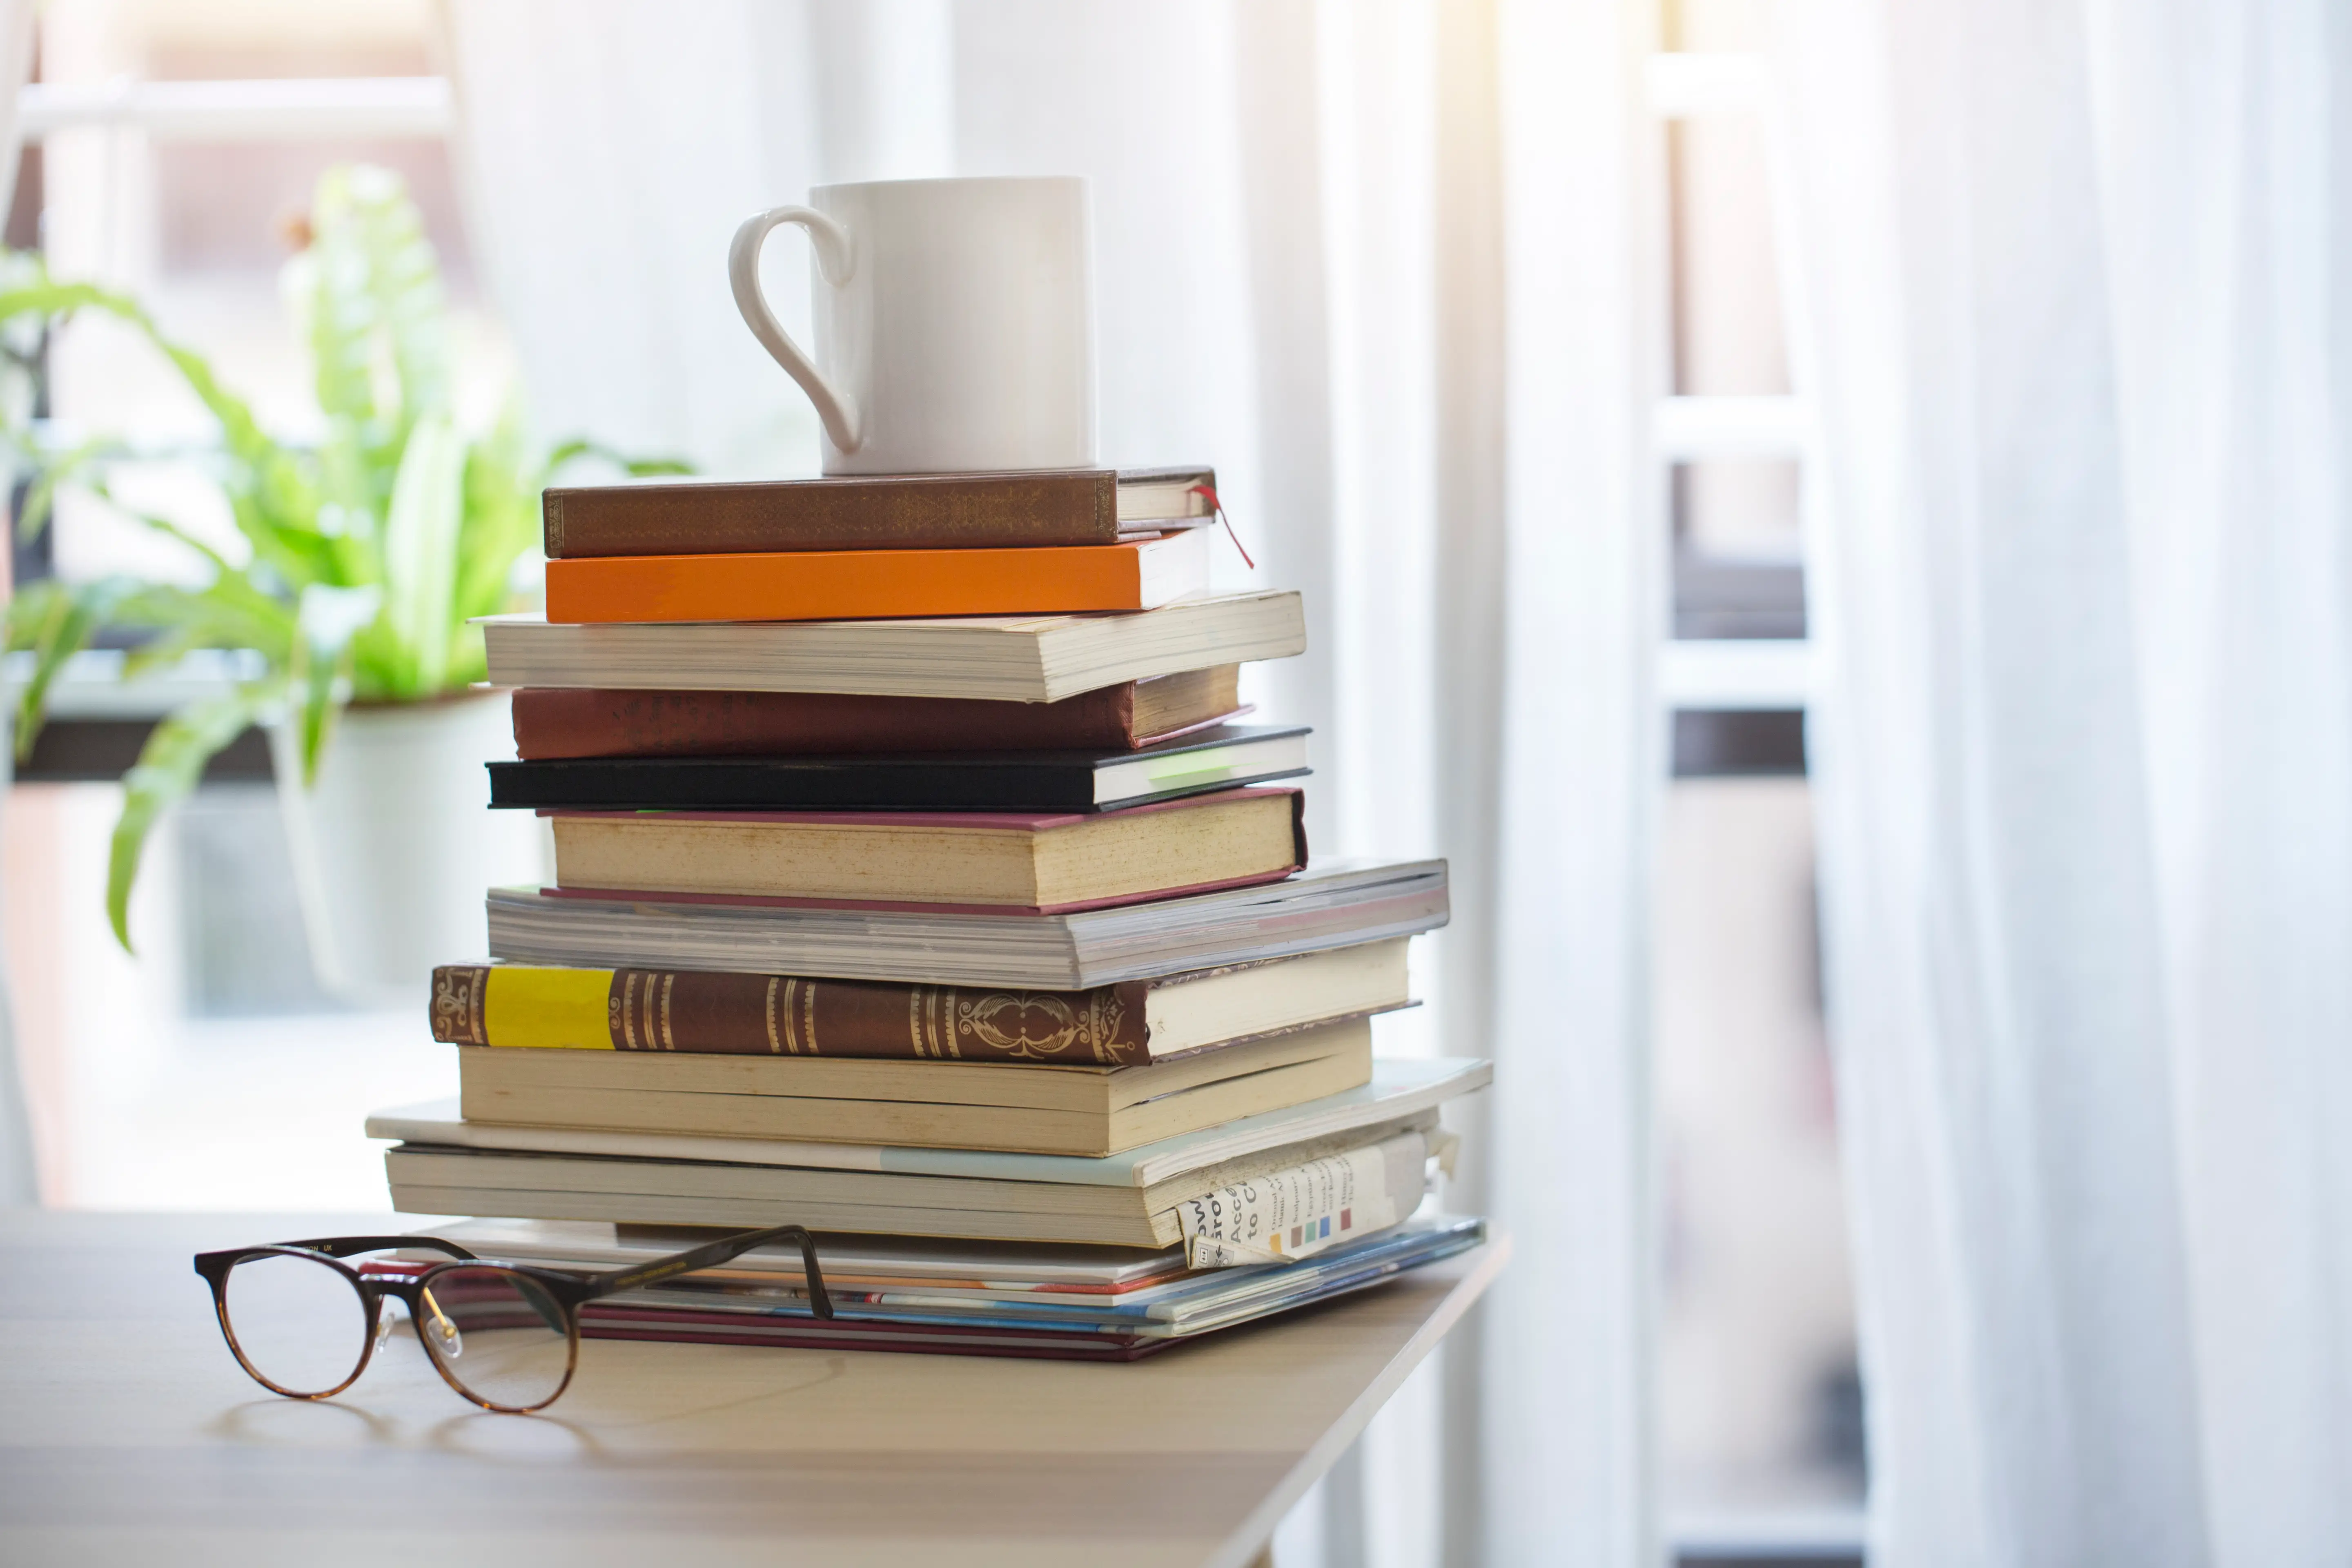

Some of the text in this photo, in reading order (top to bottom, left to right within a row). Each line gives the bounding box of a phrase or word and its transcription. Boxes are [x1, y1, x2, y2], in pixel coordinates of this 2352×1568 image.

[1274, 1177, 1283, 1192] Art
[1291, 1176, 1300, 1223] Sculptures
[1225, 1187, 1242, 1243] Acce
[1247, 1213, 1258, 1240] to
